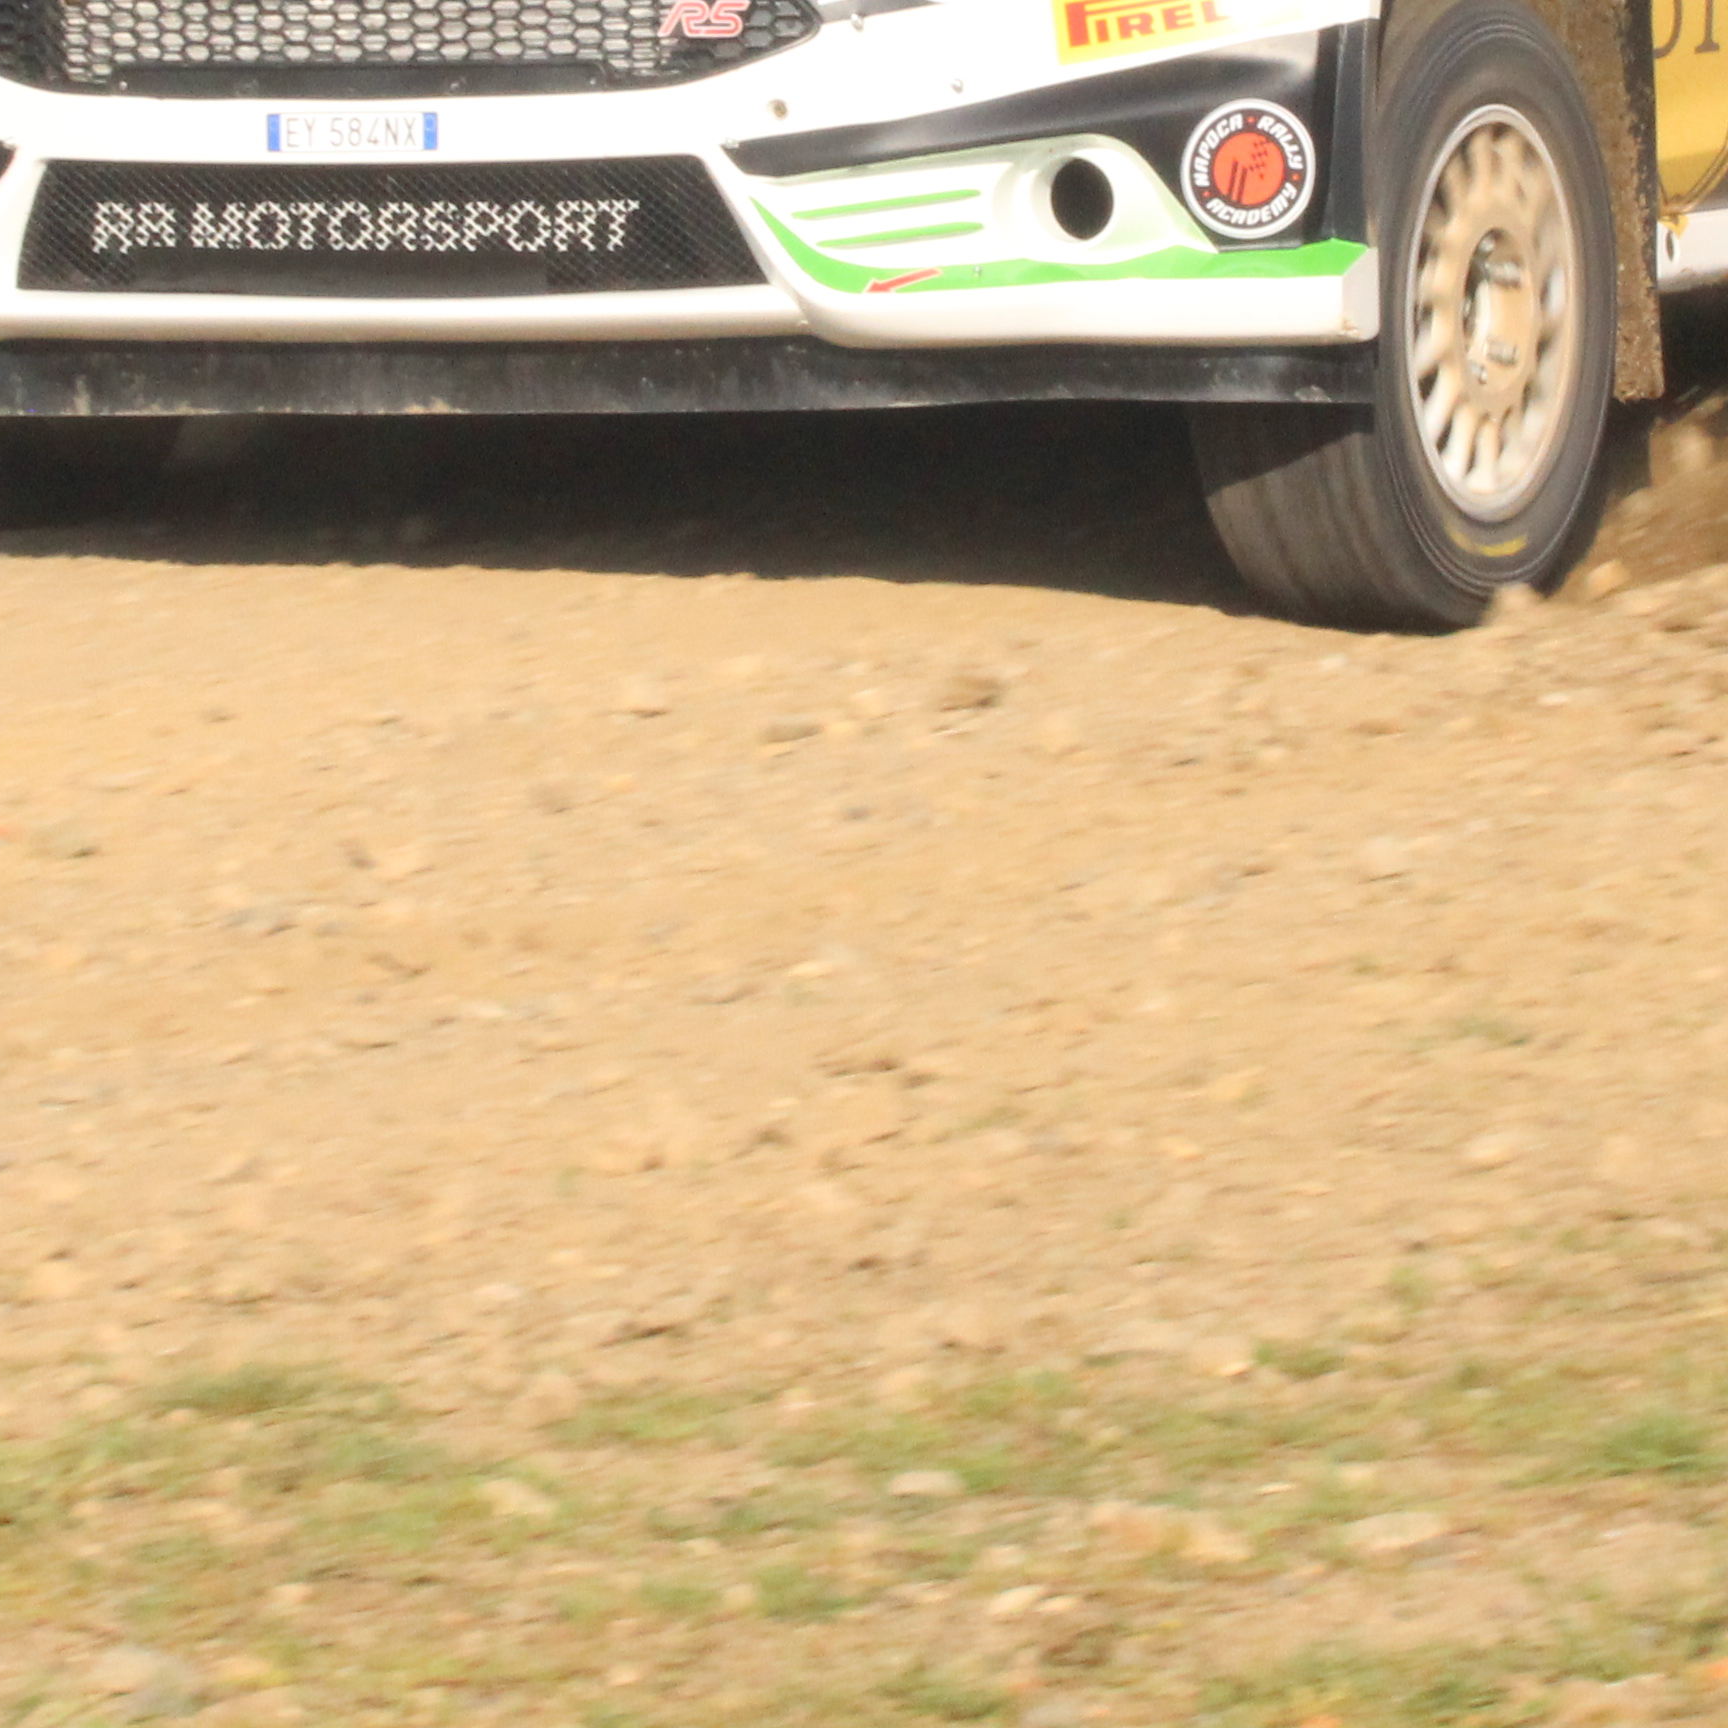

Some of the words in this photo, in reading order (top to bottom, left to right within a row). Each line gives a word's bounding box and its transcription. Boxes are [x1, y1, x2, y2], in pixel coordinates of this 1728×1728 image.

[286, 117, 316, 148] EY
[329, 116, 417, 148] 584NX
[1193, 114, 1244, 188] NAPOCA
[1257, 114, 1304, 170] RALLY
[189, 199, 641, 253] MOTORSPORT
[1206, 181, 1298, 226] ACADEMY
